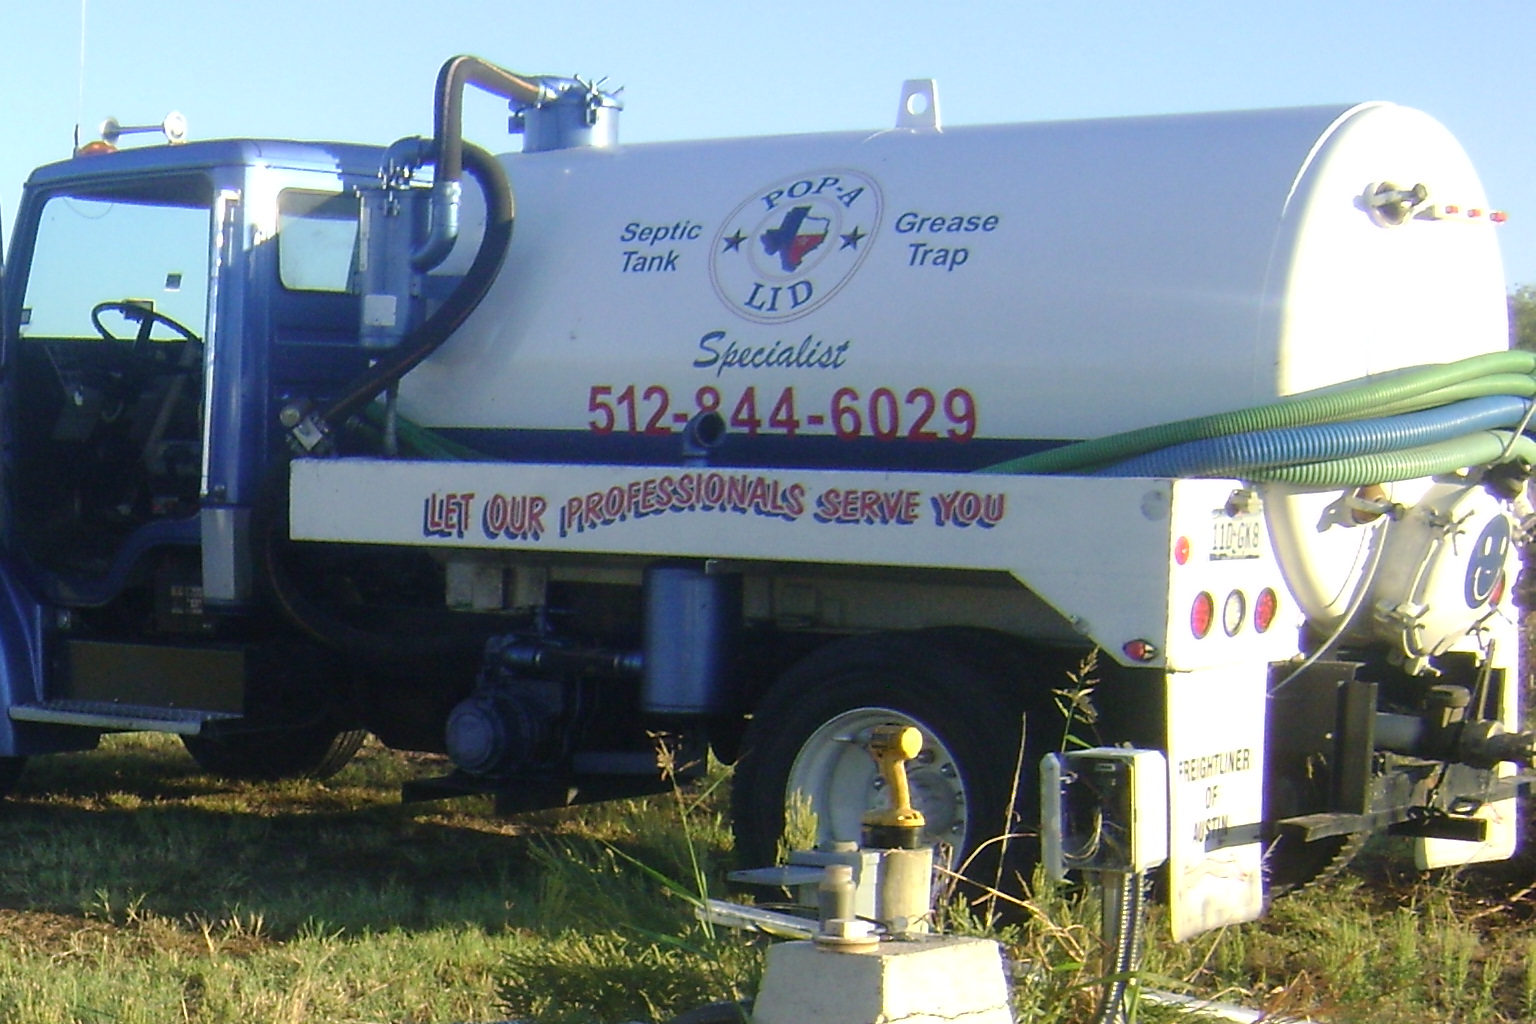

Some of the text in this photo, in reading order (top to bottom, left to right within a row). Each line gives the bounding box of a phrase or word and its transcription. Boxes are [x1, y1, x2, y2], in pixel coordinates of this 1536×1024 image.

[761, 176, 865, 211] POP-A
[620, 221, 702, 245] Septic
[894, 211, 999, 236] Grease
[621, 251, 680, 275] Tank
[908, 243, 970, 272] Trap
[745, 279, 814, 312] LID
[693, 330, 852, 378] Specialist
[424, 472, 1006, 542] LET OUR PROFESSIONALS SERVE YOU
[1178, 748, 1251, 782] FREIGHTLINER
[1205, 785, 1218, 809] OF
[1193, 815, 1229, 842] AUSTIN
